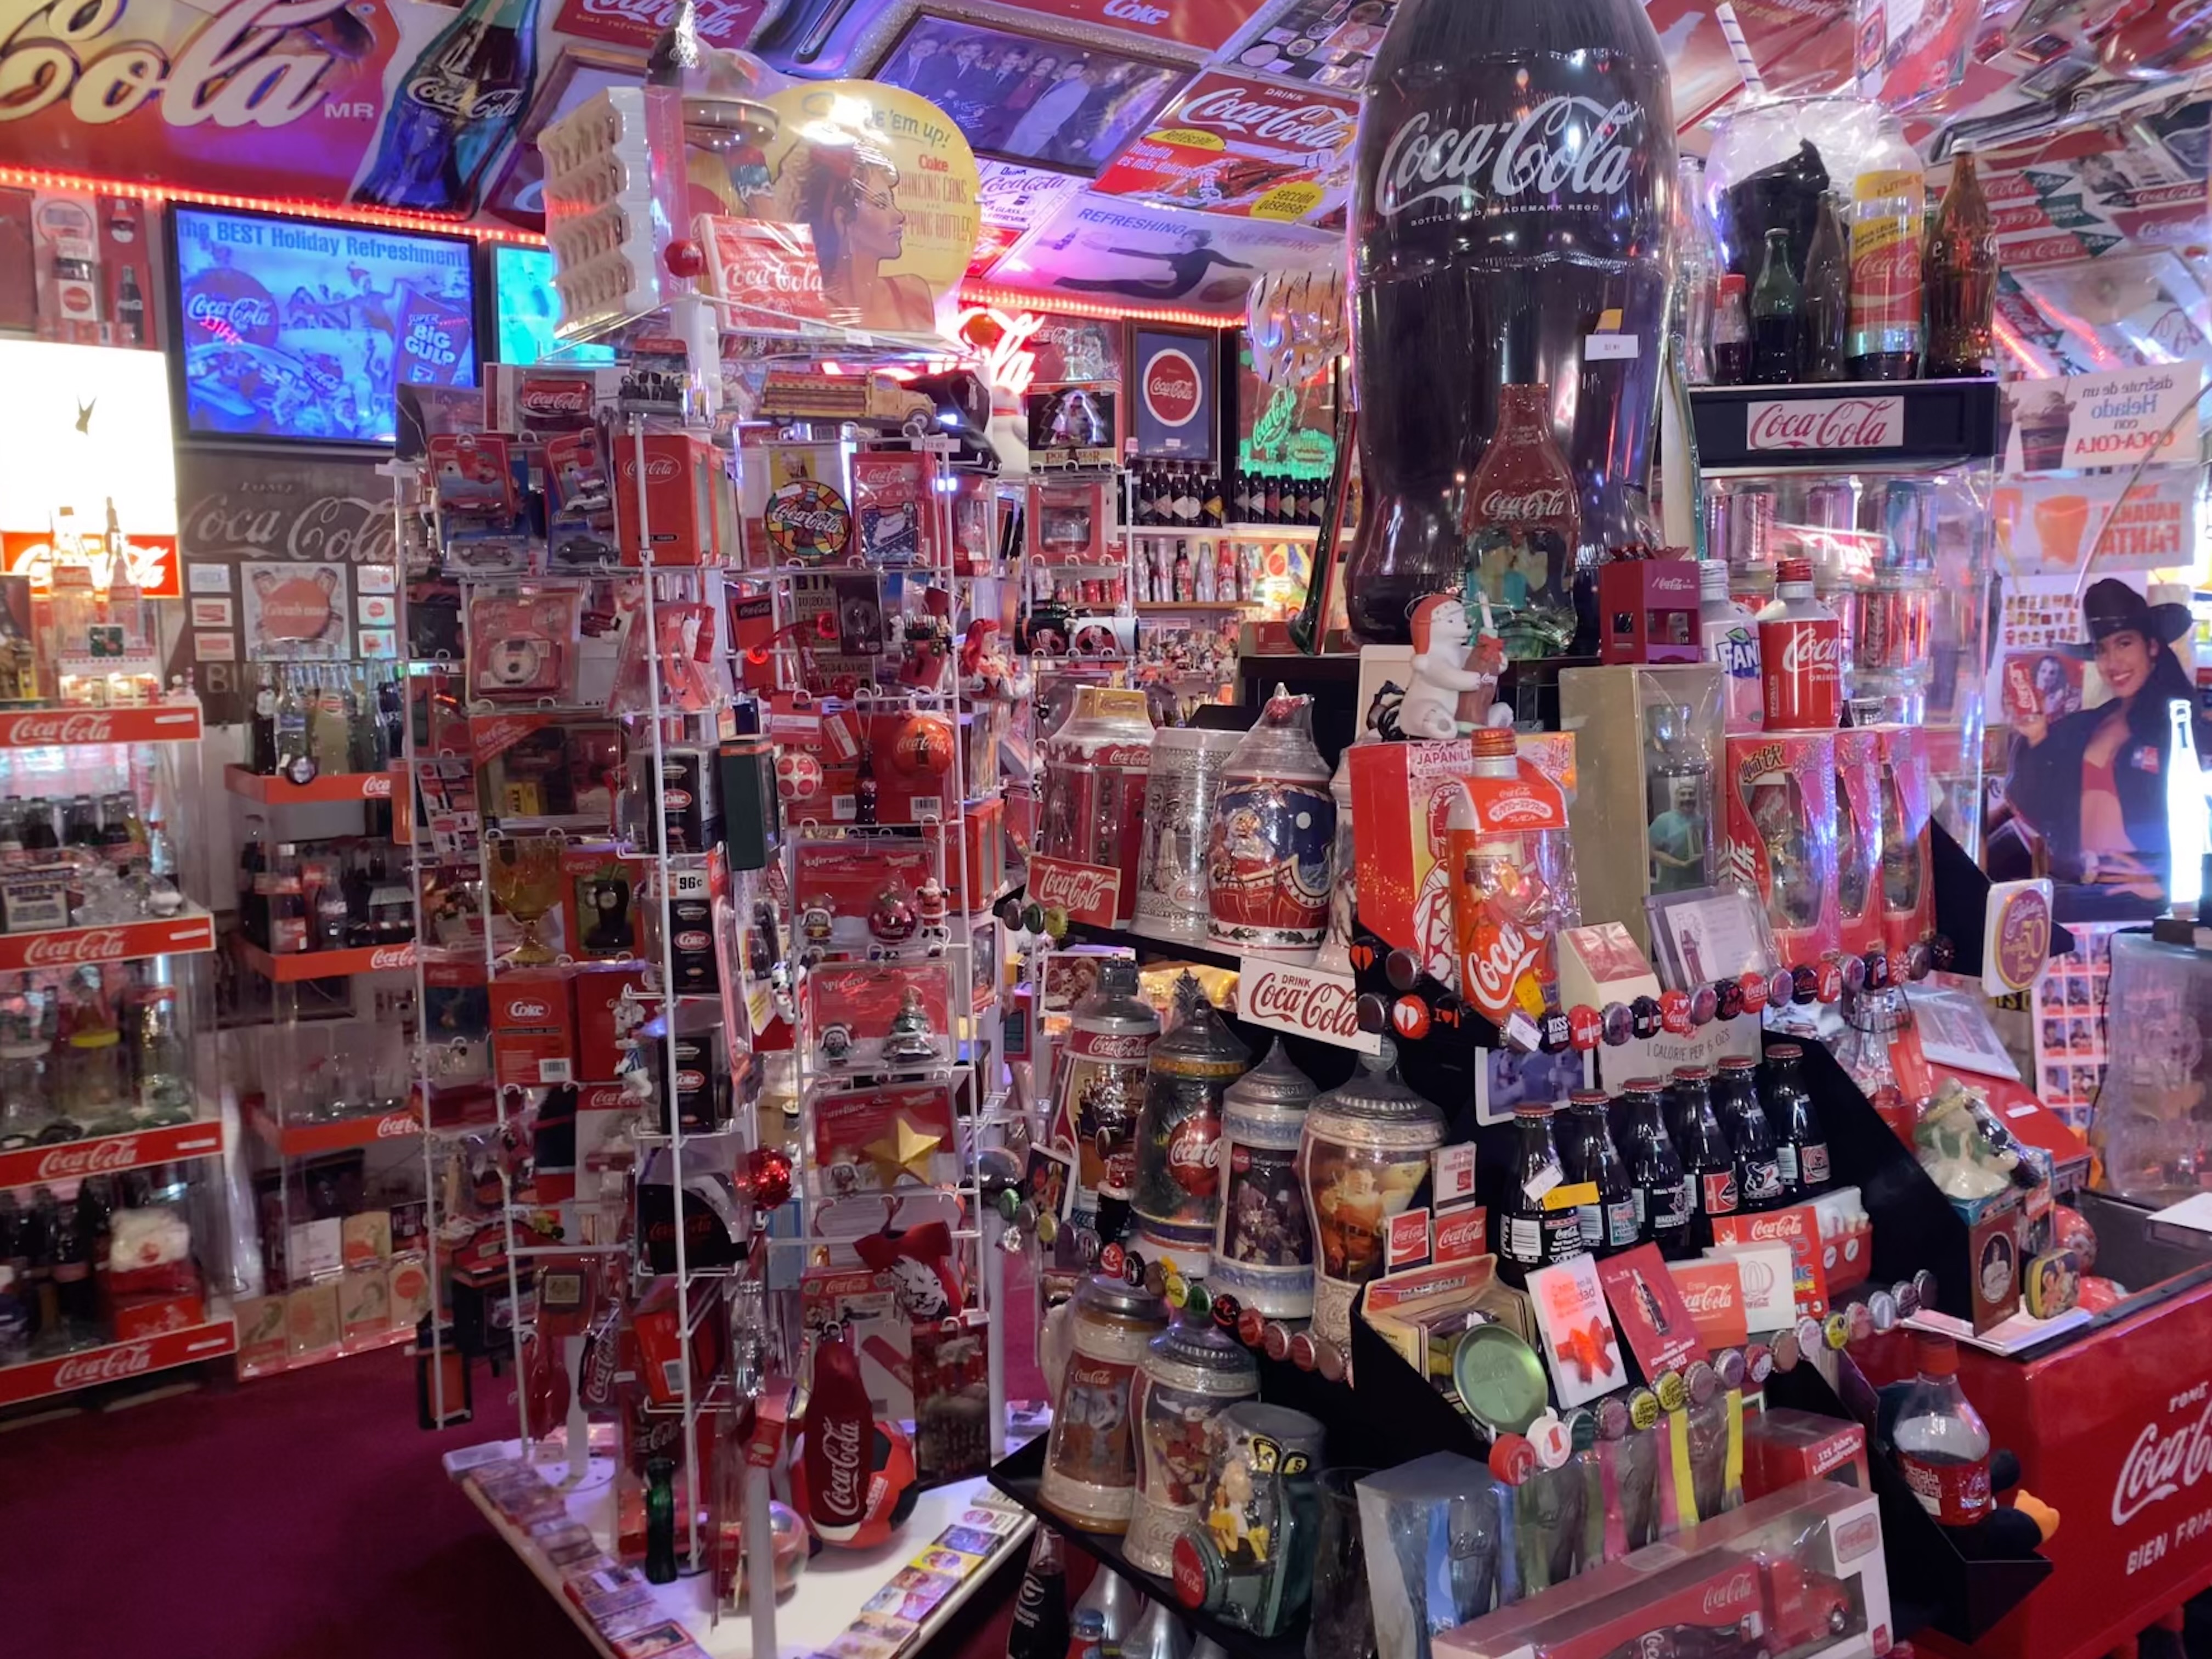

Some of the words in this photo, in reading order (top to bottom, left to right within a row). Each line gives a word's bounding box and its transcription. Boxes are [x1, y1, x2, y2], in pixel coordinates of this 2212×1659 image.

[1263, 87, 1309, 101] DRINK
[324, 103, 374, 119] MR
[1178, 88, 1359, 148] Coca-Cola
[918, 154, 949, 172] Coke
[1375, 95, 1641, 218] Coca-Cola
[1410, 212, 1454, 227] BOTTLE
[217, 221, 264, 246] BEST
[272, 228, 340, 258] Holiday
[724, 261, 823, 294] Coca-Cola
[188, 293, 270, 327] Coca-Cola
[403, 336, 457, 367] GULP
[413, 325, 452, 349] BIG
[525, 391, 585, 411] Coca-Cola
[1151, 377, 1194, 401] Coca-Cola
[1750, 399, 1897, 449] Coca-Cola
[771, 503, 842, 534] Coca-Cola
[1482, 488, 1567, 521] Coca-Cola
[10, 713, 112, 743] Coca-Cola
[1108, 748, 1152, 766] Coca-Cola
[1417, 751, 1457, 765] JAPAN
[1040, 865, 1118, 912] Coca-Cola
[25, 931, 125, 966] Coca-Cola
[677, 934, 707, 947] Coke
[1281, 974, 1311, 988] DRINK
[506, 1001, 545, 1018] Coke
[1250, 972, 1359, 1038] Coca-Cola
[1548, 1015, 1568, 1031] KISS
[1087, 1035, 1149, 1057] Coca-Cola
[1653, 1043, 1686, 1062] CALORIE
[1689, 1045, 1705, 1060] PER
[1707, 1039, 1713, 1051] 6
[37, 1138, 138, 1177] Coca-Cola
[1438, 1220, 1483, 1249] Coca-Cola
[1751, 1214, 1802, 1241] Coca-Cola
[825, 1277, 868, 1295] Coca-Cola
[54, 1345, 151, 1387] Coca-Cola
[1073, 1369, 1111, 1386] Coca-Cola
[2168, 1381, 2209, 1413] TOME
[822, 1417, 860, 1517] Coca-Cola
[2126, 1532, 2169, 1576] BIEN
[1703, 1573, 1752, 1615] Coca-Cola
